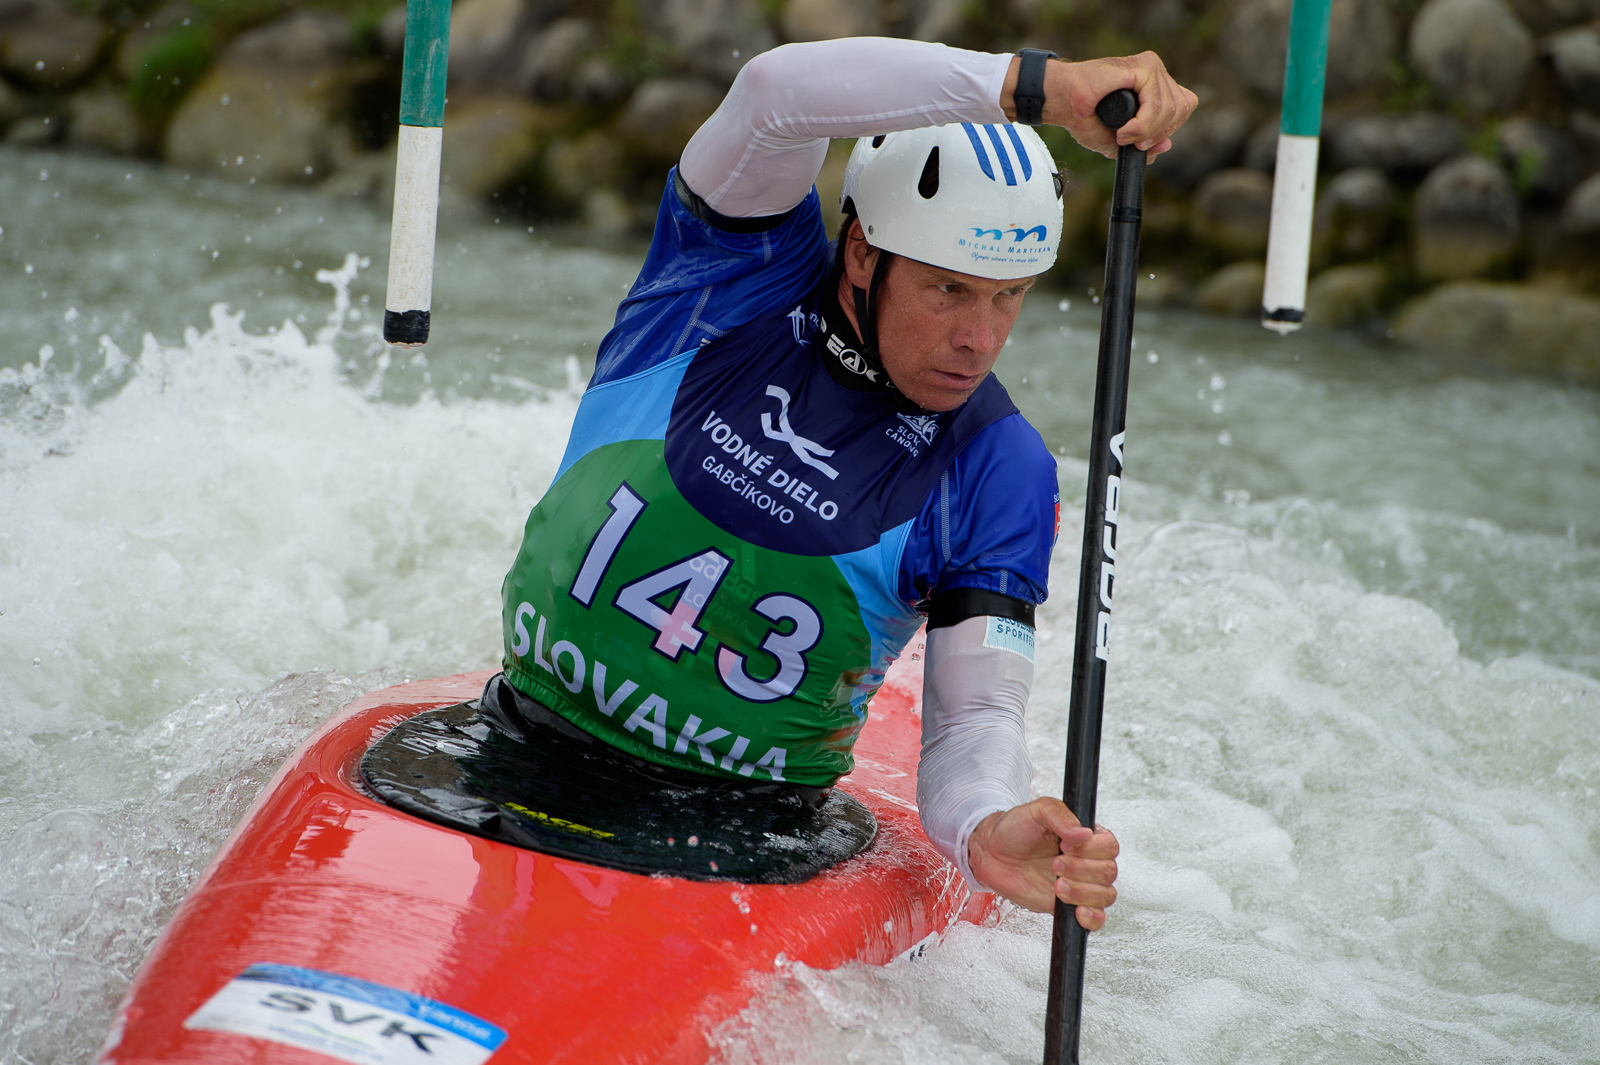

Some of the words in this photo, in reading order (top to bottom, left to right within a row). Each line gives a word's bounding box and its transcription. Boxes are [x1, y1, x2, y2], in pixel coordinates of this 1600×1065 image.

[701, 410, 774, 477] VODNÉ
[767, 468, 839, 521] DIELO
[702, 455, 795, 524] GABČÍKOVO
[567, 479, 824, 704] 143
[511, 601, 788, 782] SLOVAKIA
[258, 991, 446, 1056] SVK
